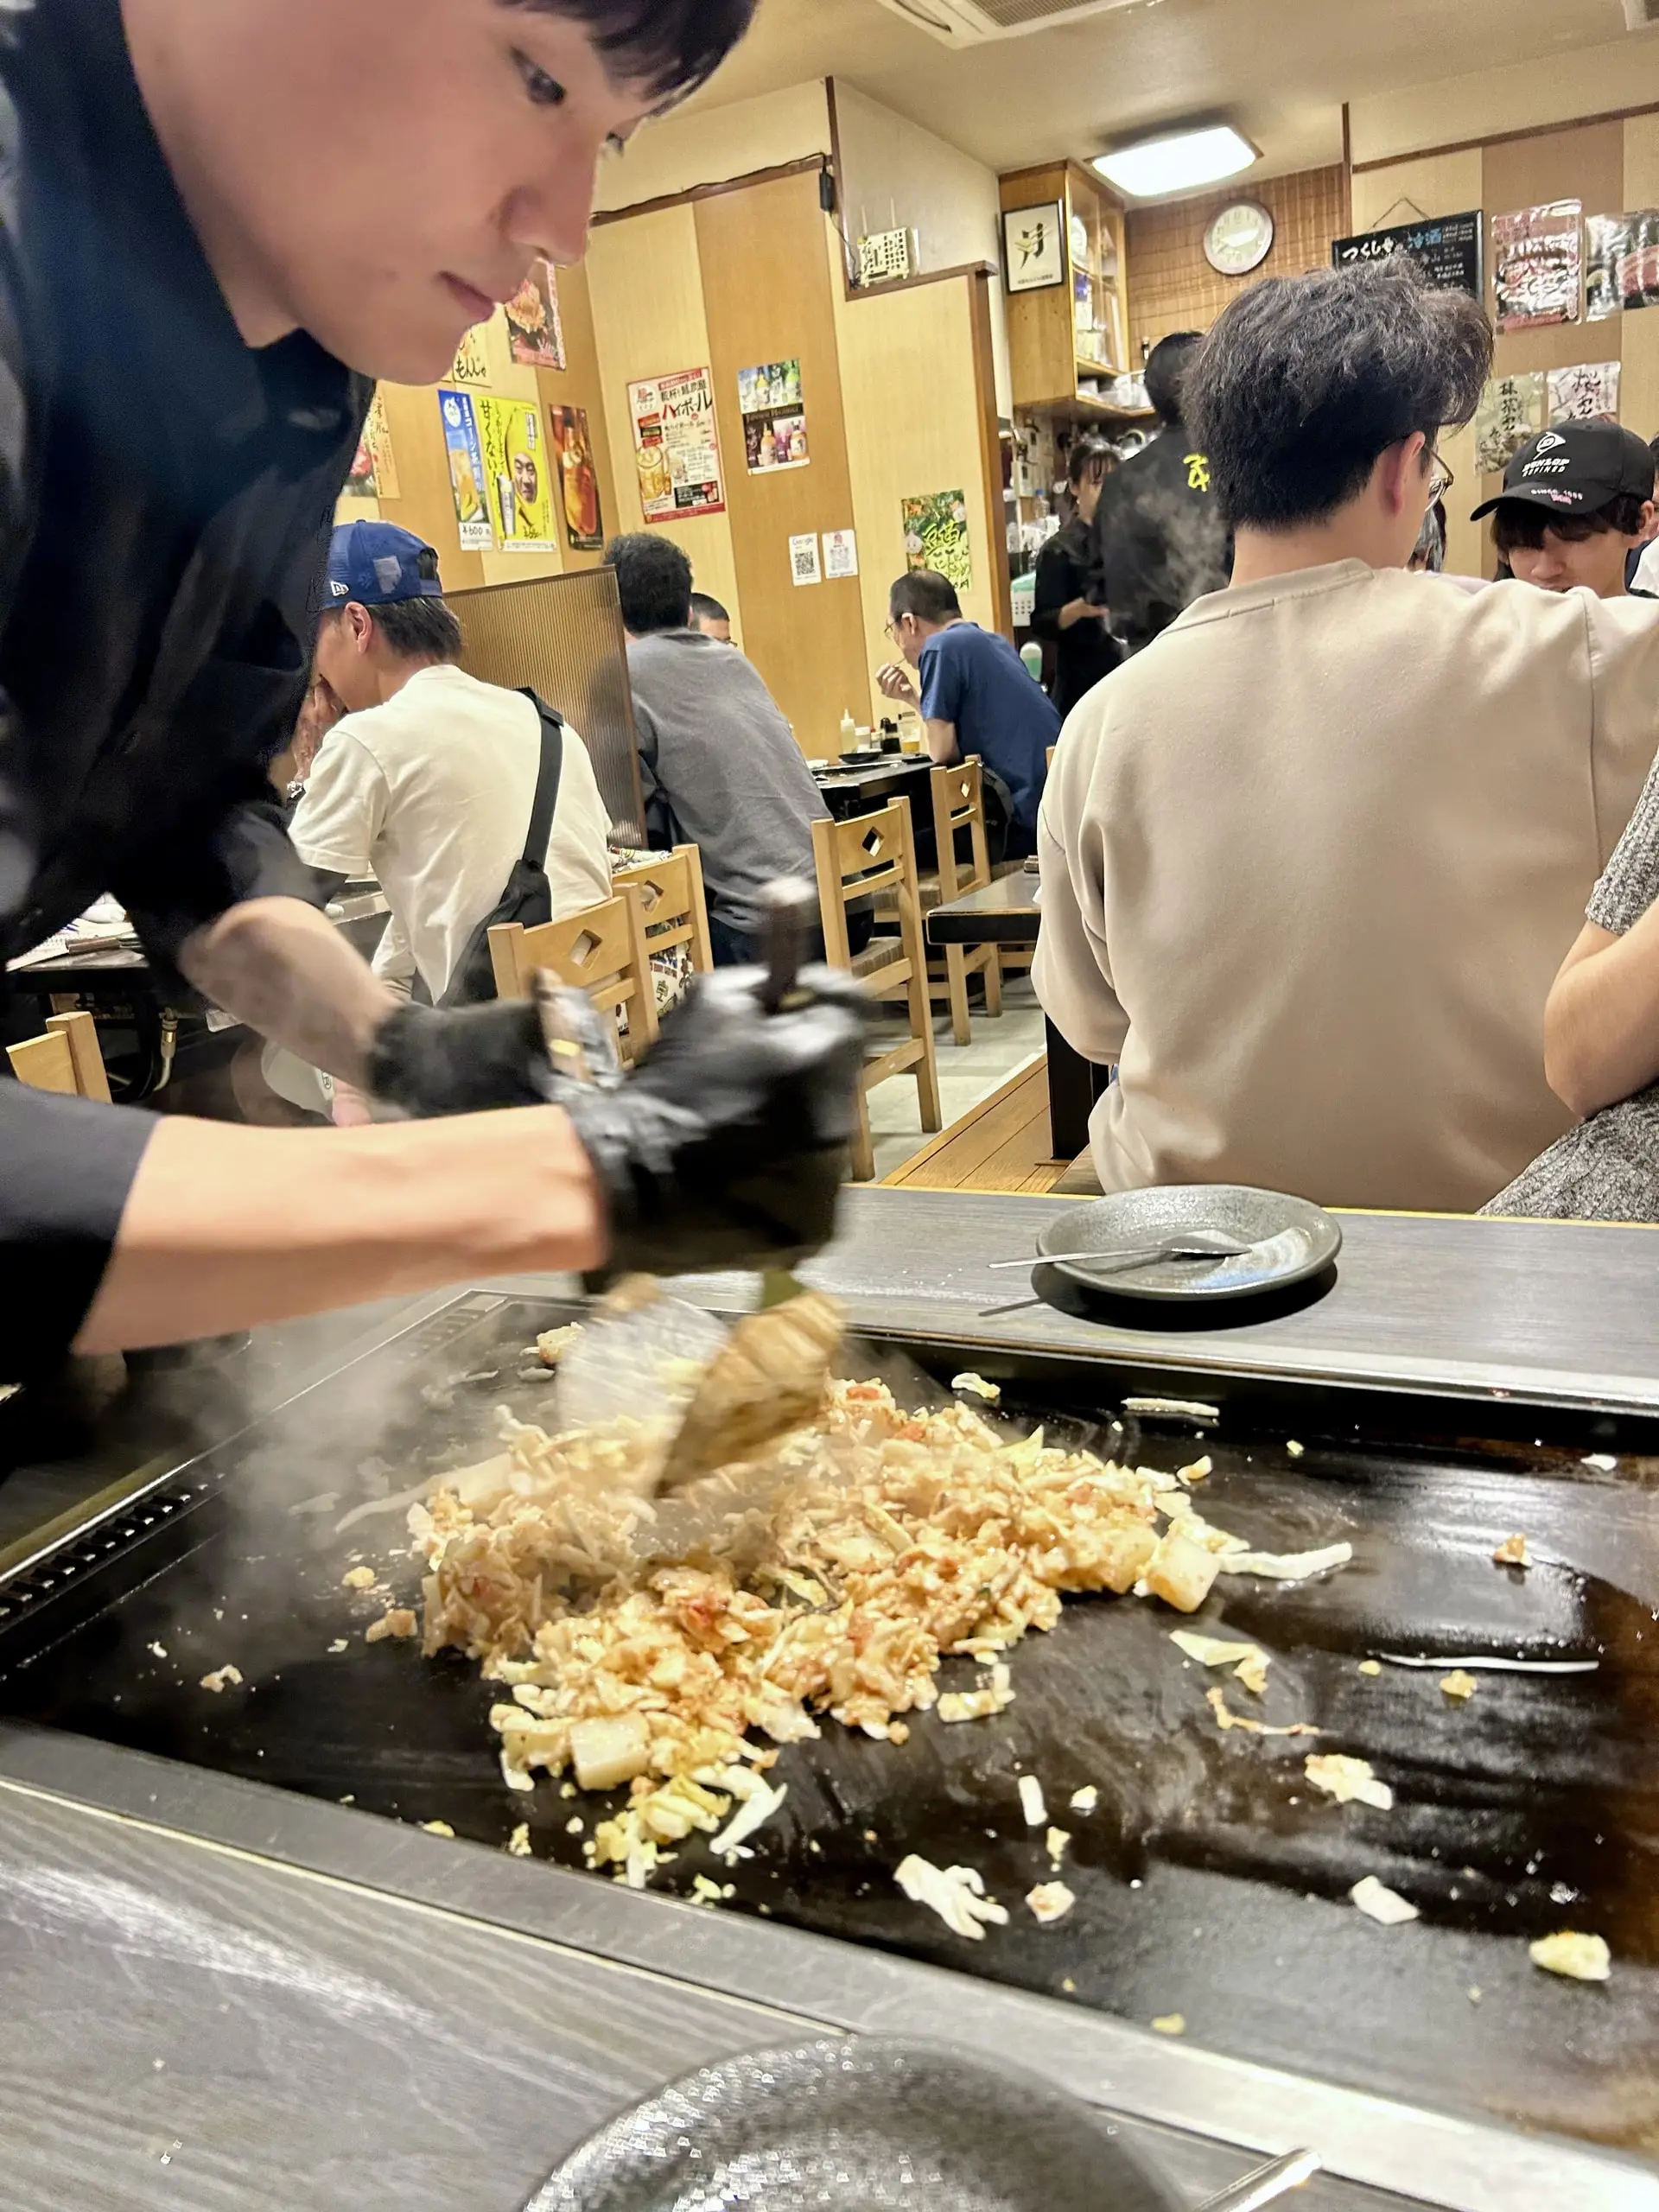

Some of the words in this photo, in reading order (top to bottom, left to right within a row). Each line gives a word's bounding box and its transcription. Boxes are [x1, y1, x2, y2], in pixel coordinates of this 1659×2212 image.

[662, 389, 713, 420] ハイボール
[1522, 458, 1571, 473] DUNLOP
